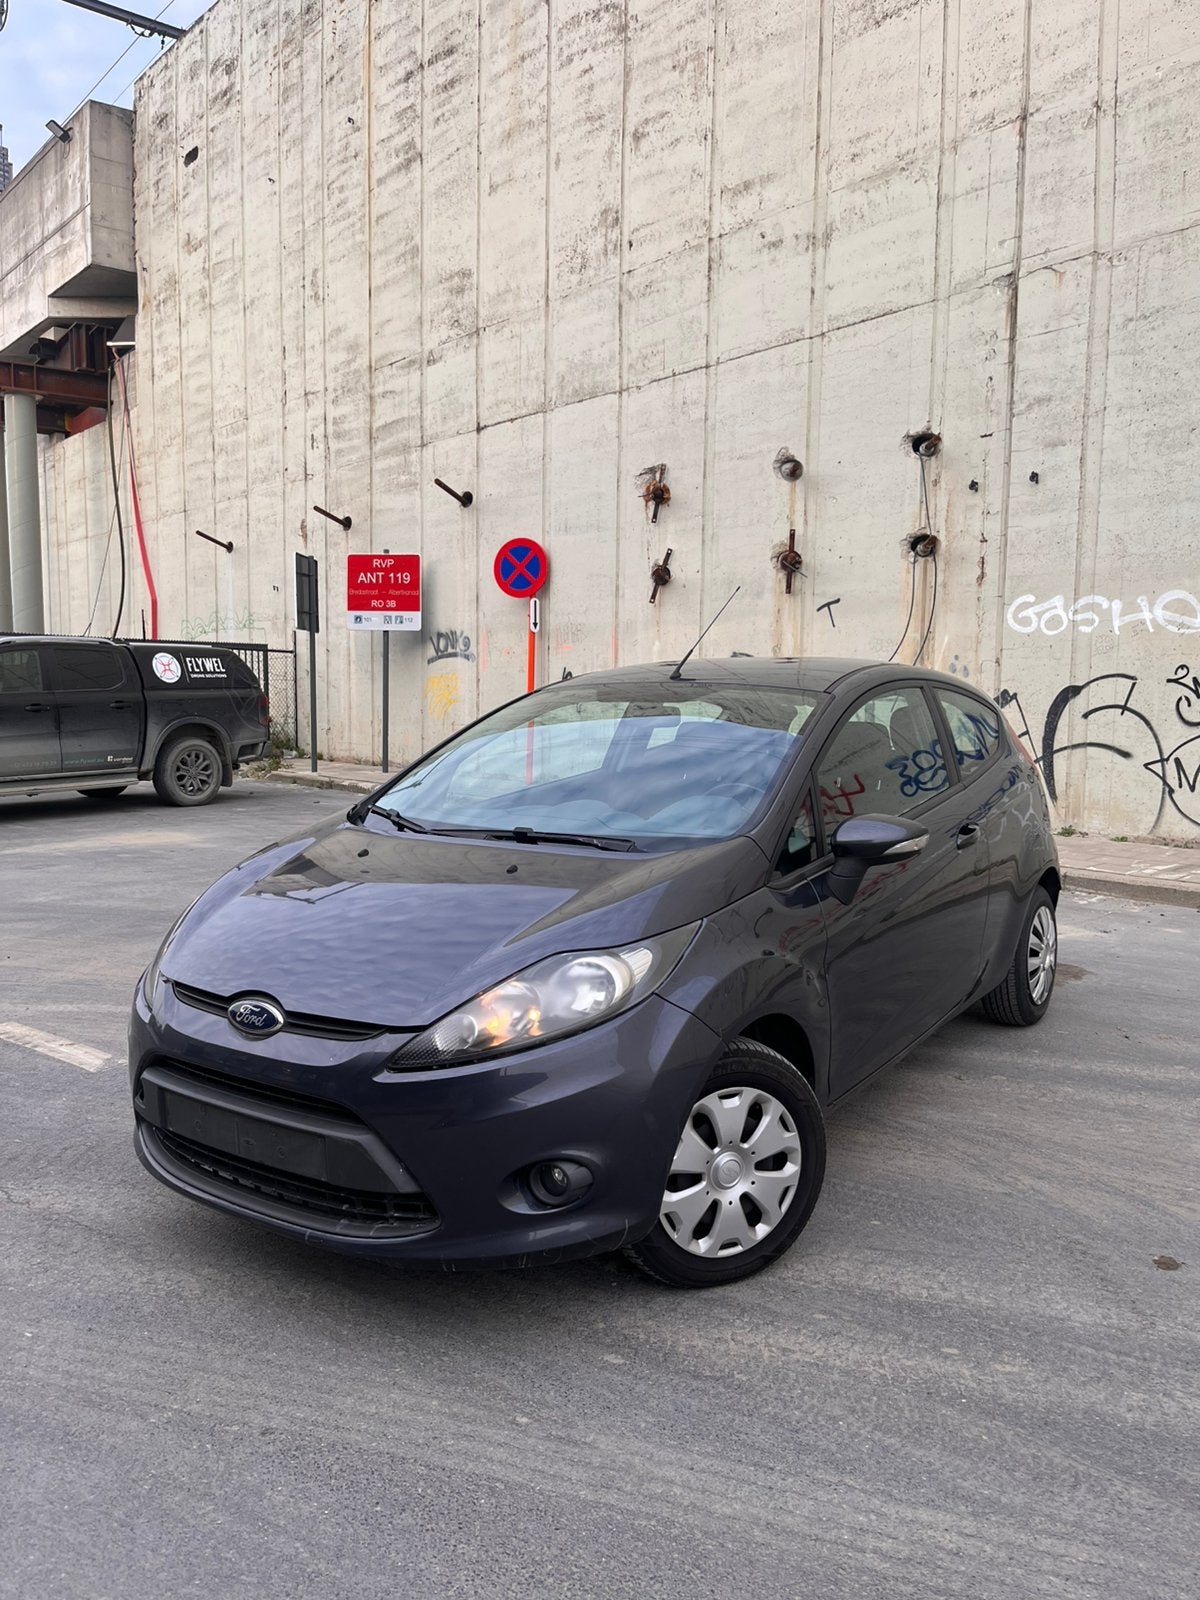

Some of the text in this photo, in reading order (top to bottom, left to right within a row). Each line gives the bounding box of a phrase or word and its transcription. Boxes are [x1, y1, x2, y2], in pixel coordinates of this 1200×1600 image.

[373, 558, 394, 568] RVP
[357, 572, 411, 584] ANT 119
[371, 599, 397, 608] RO 3B
[185, 657, 226, 672] FLYWEL
[236, 1004, 267, 1026] Ford
